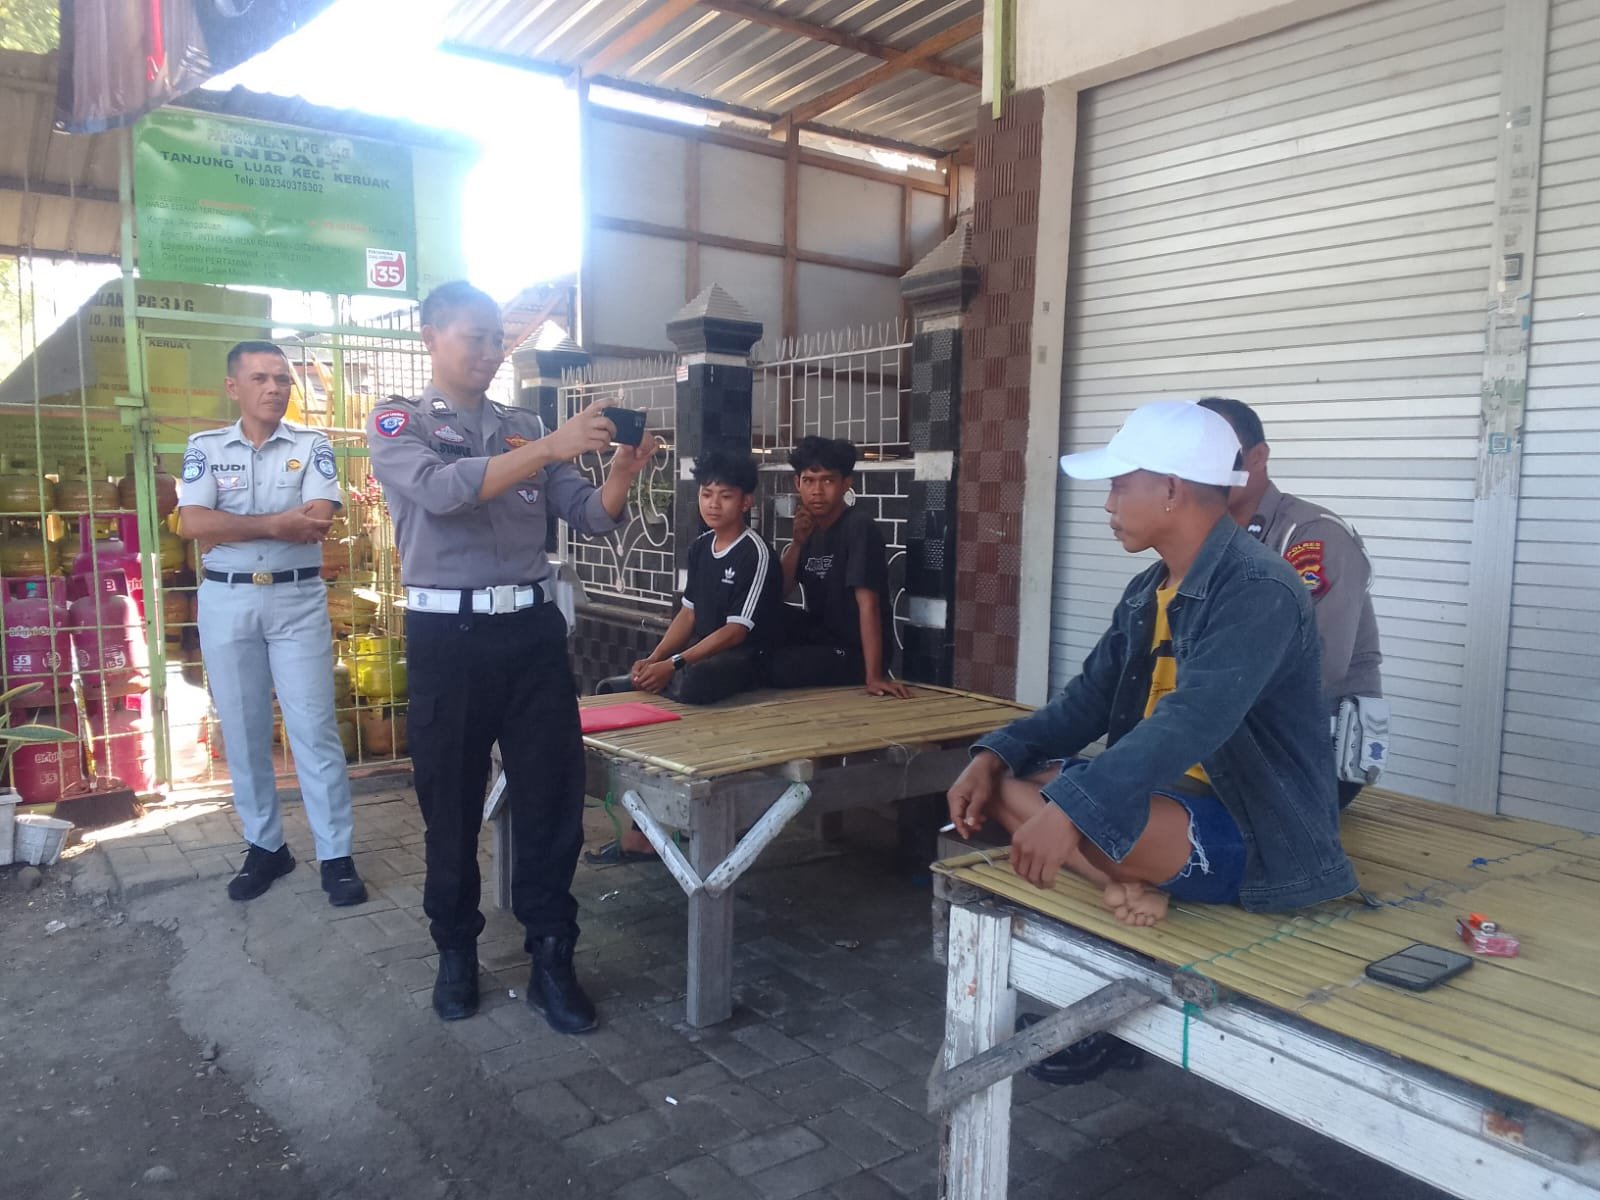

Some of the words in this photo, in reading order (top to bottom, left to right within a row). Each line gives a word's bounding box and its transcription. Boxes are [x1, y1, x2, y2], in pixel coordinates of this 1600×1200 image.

[294, 138, 320, 155] LPG
[160, 150, 235, 169] TANJUNG
[244, 161, 283, 176] LUAR
[292, 167, 326, 181] KEC.
[333, 171, 392, 189] KERUAK
[371, 264, 401, 283] 135
[210, 464, 246, 473] RUDI
